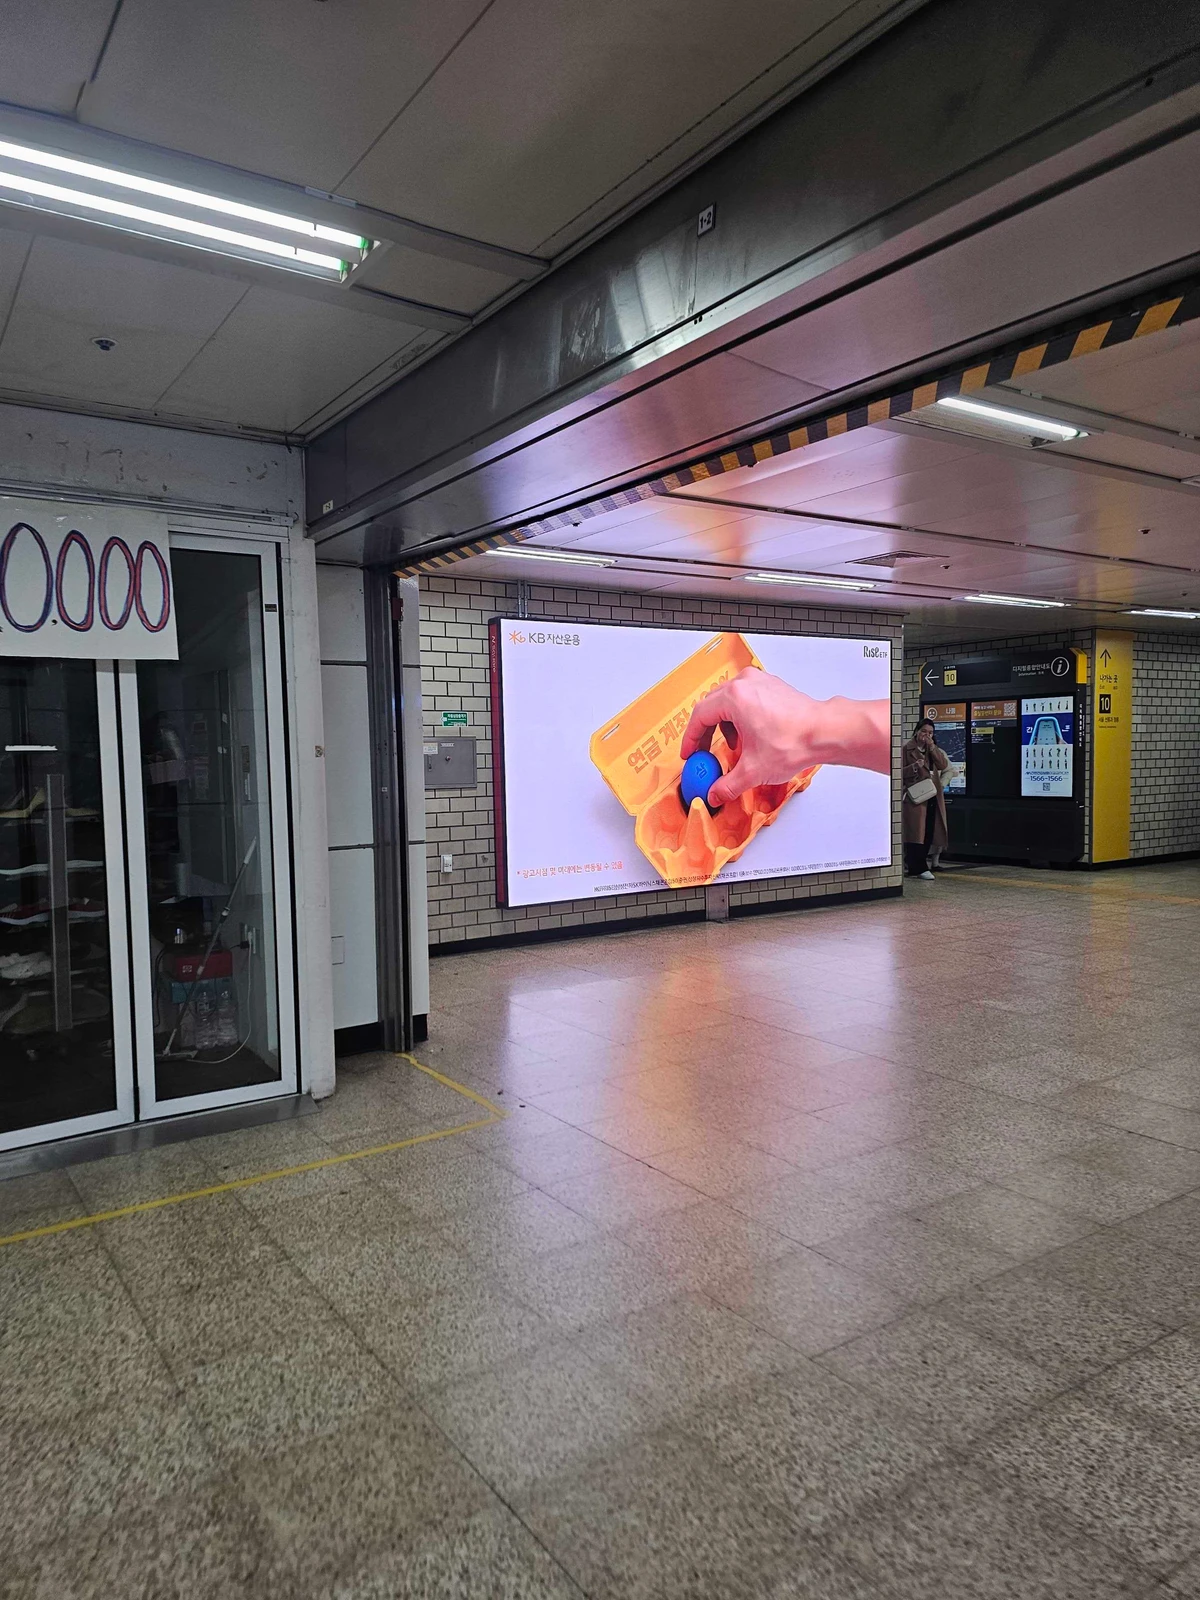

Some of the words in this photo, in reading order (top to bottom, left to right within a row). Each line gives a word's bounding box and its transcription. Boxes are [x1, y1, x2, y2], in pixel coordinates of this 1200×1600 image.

[945, 673, 955, 682] 10
[1100, 697, 1110, 711] 10
[627, 736, 662, 774] 연금
